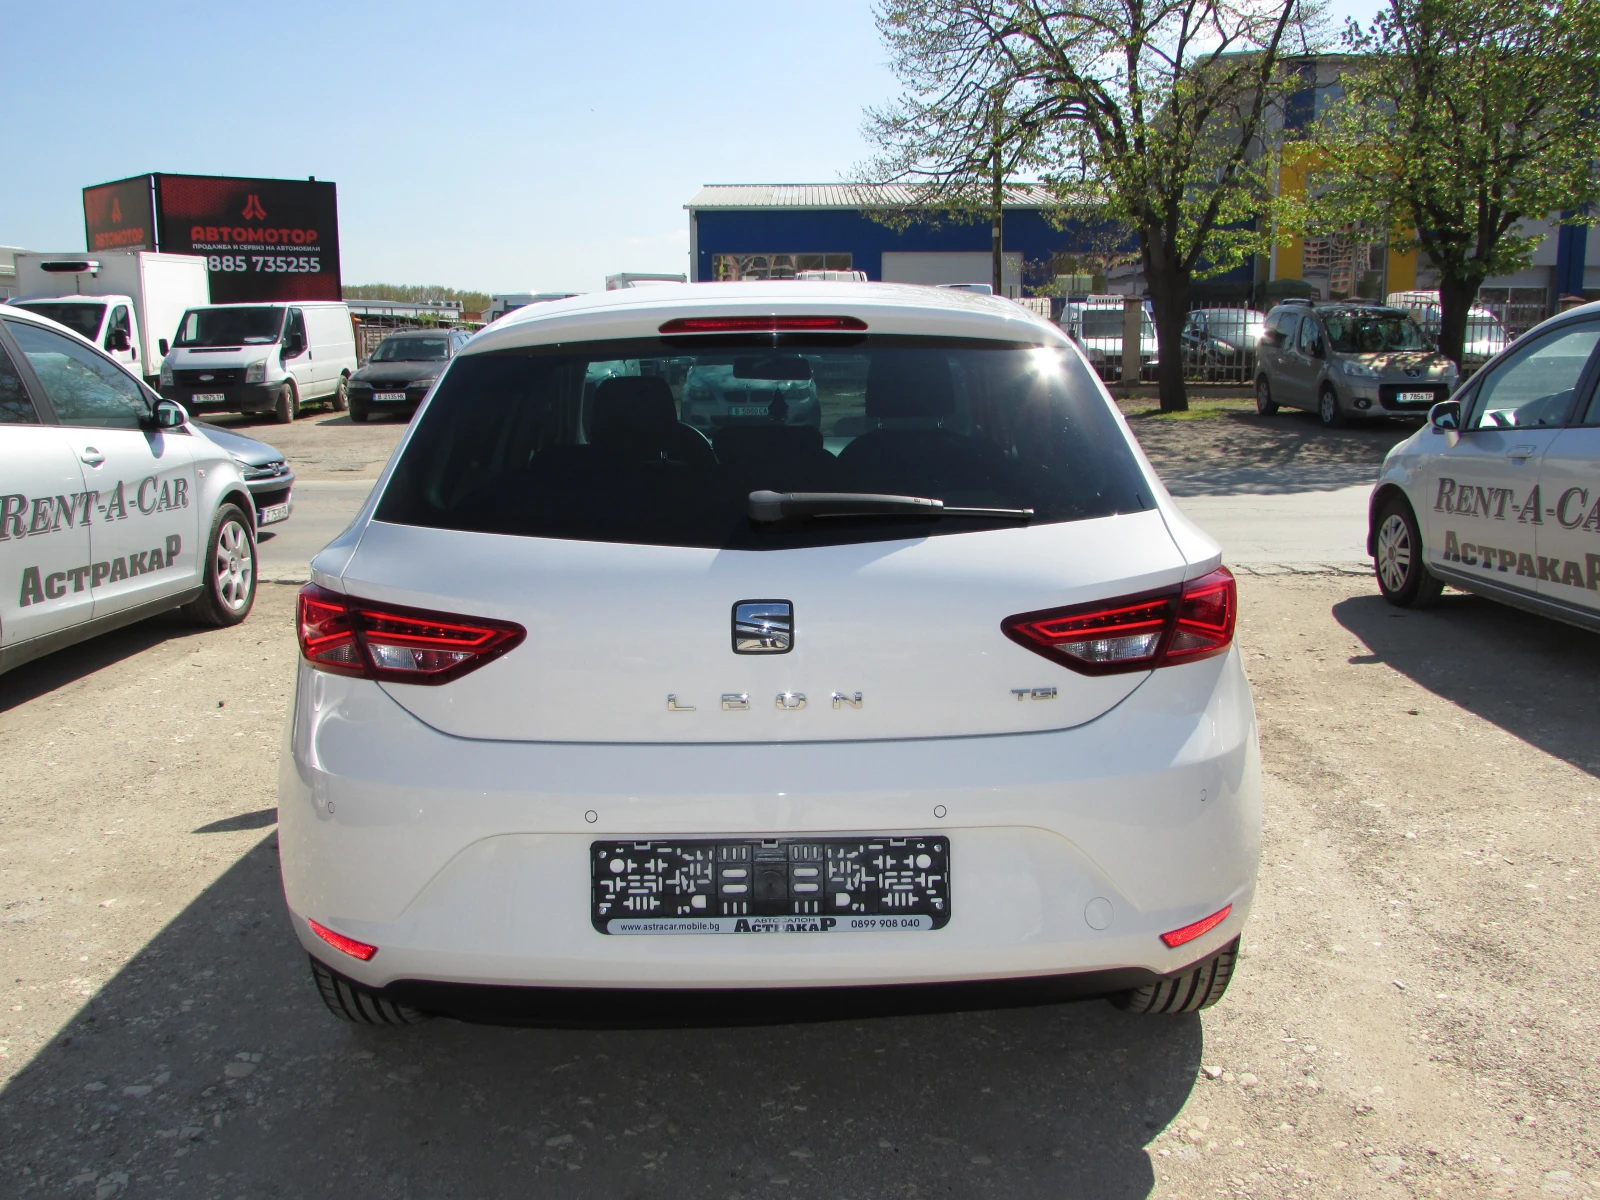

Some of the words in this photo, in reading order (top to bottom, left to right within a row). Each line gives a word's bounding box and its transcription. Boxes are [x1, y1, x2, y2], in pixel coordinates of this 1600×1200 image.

[191, 226, 318, 243] АВТОМОТОР
[252, 256, 320, 273] 735255
[668, 692, 862, 711] LEON
[1010, 687, 1057, 701] TGI
[620, 922, 720, 932] www.astracar.mobile.bg
[851, 919, 876, 928] 0899
[879, 919, 898, 928] 908
[901, 919, 920, 928] 040
